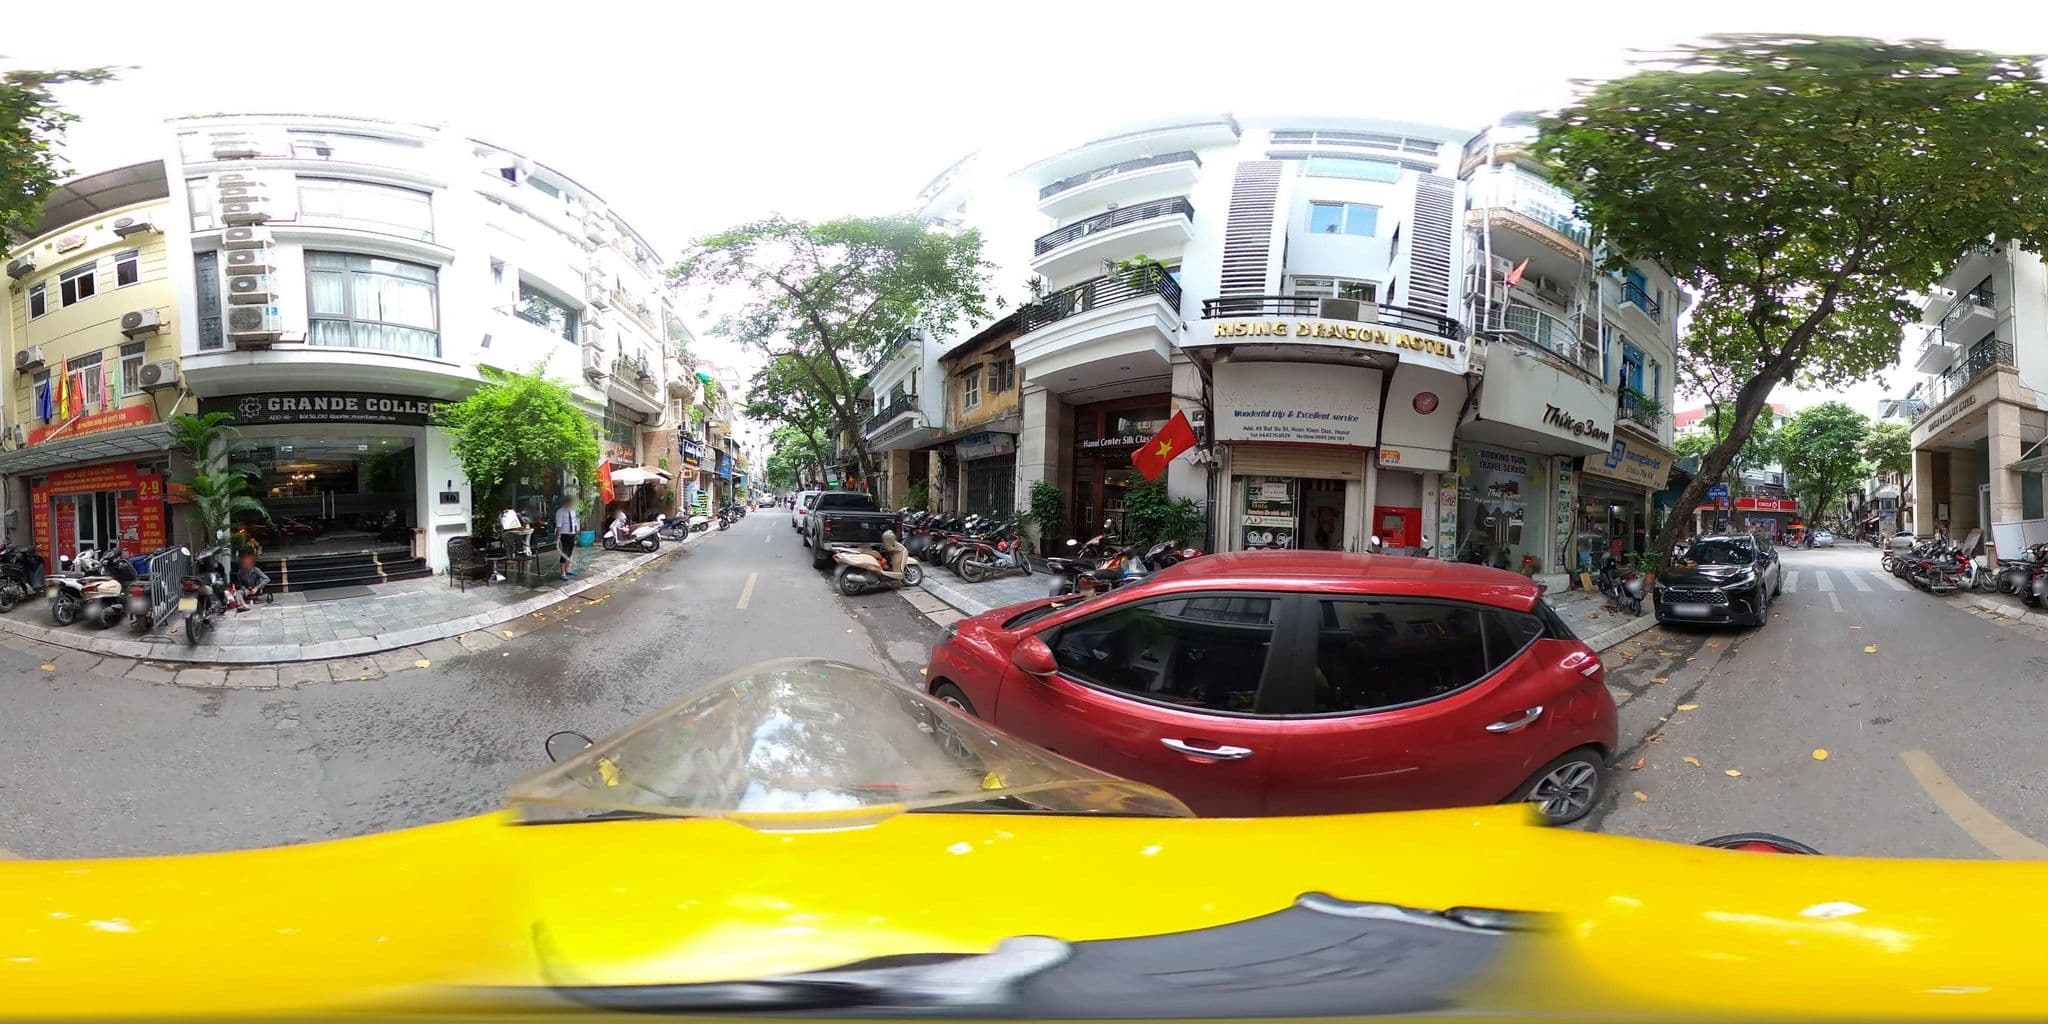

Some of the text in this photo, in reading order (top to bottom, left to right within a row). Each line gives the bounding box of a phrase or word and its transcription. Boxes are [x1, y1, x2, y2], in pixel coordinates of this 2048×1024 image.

[1214, 321, 1456, 359] RISING DRAGON HOTEL
[268, 397, 359, 411] GRANDE
[1234, 408, 1359, 423] Wonderful trip & Excellent service
[1100, 437, 1121, 447] Center
[1122, 435, 1134, 445] Silk
[1479, 459, 1528, 475] TRAVEL SERVICE
[140, 481, 160, 495] 2-9
